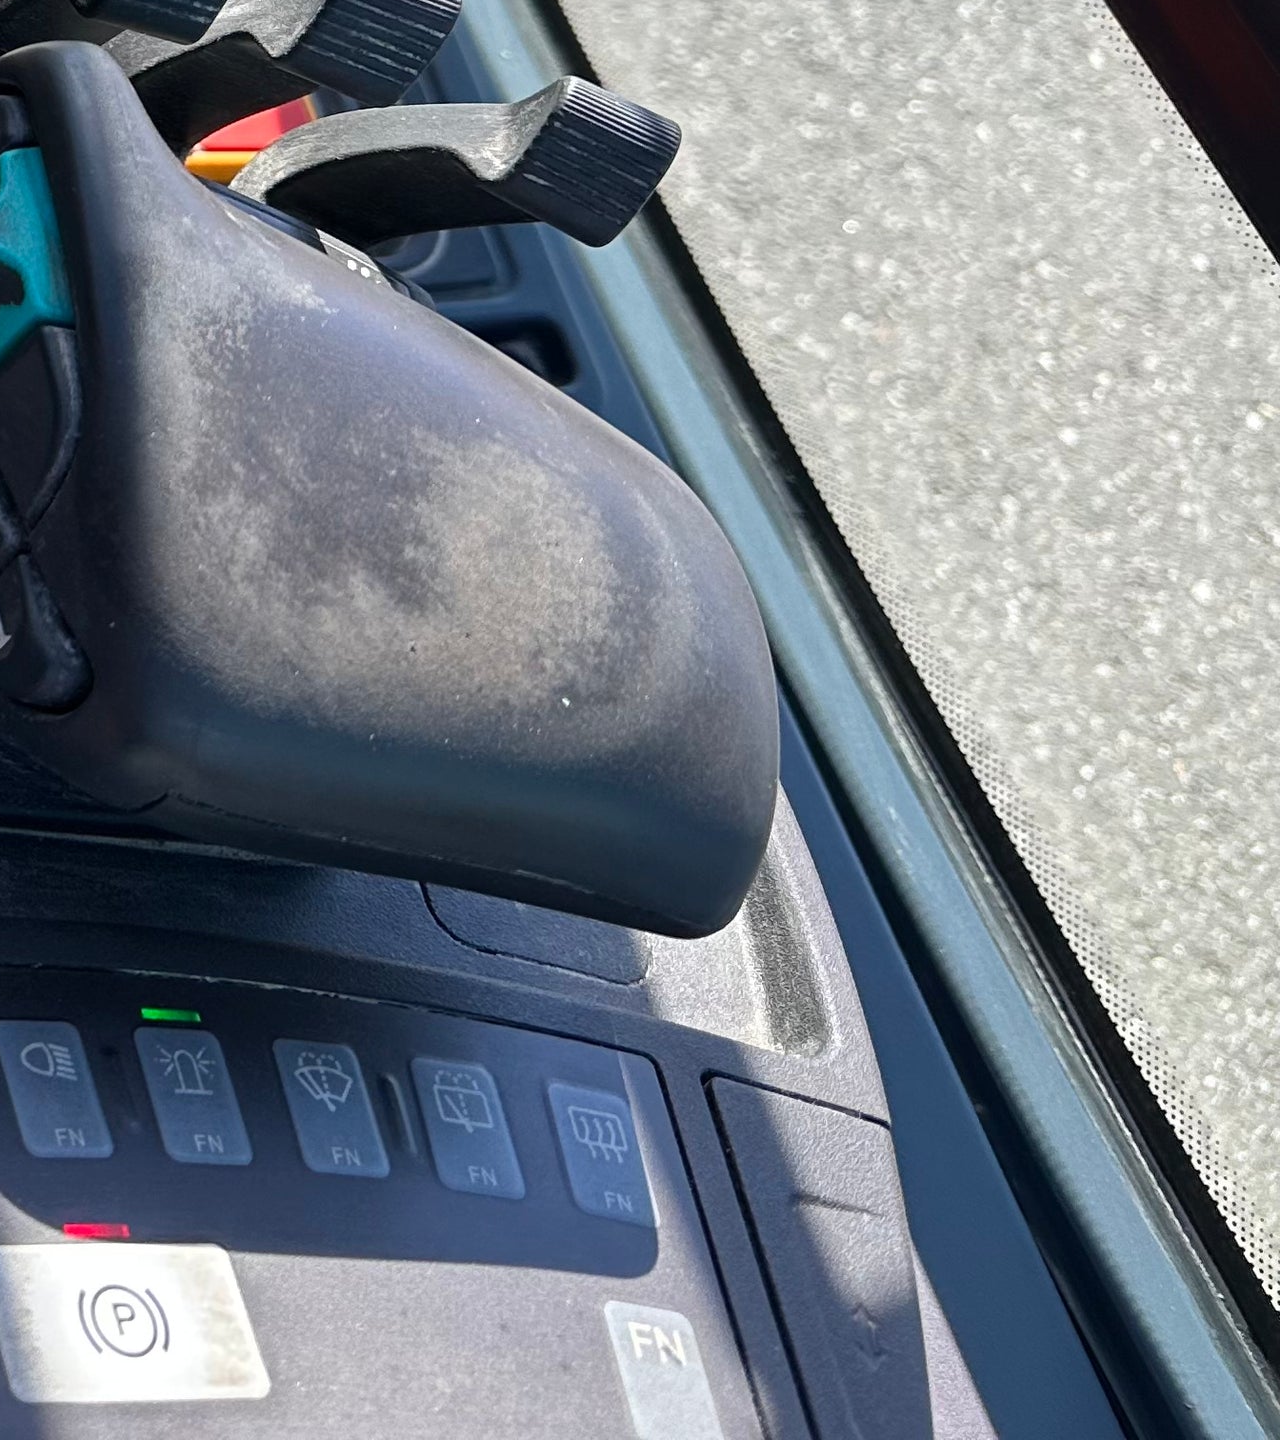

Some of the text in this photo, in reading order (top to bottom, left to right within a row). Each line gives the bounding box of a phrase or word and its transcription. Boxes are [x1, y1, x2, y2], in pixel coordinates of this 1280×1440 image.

[54, 1128, 86, 1148] FN
[193, 1133, 225, 1154] FN
[331, 1146, 361, 1167] FN
[468, 1165, 498, 1187] FN
[604, 1191, 633, 1213] FN
[112, 1303, 136, 1335] P
[627, 1320, 689, 1368] FN
